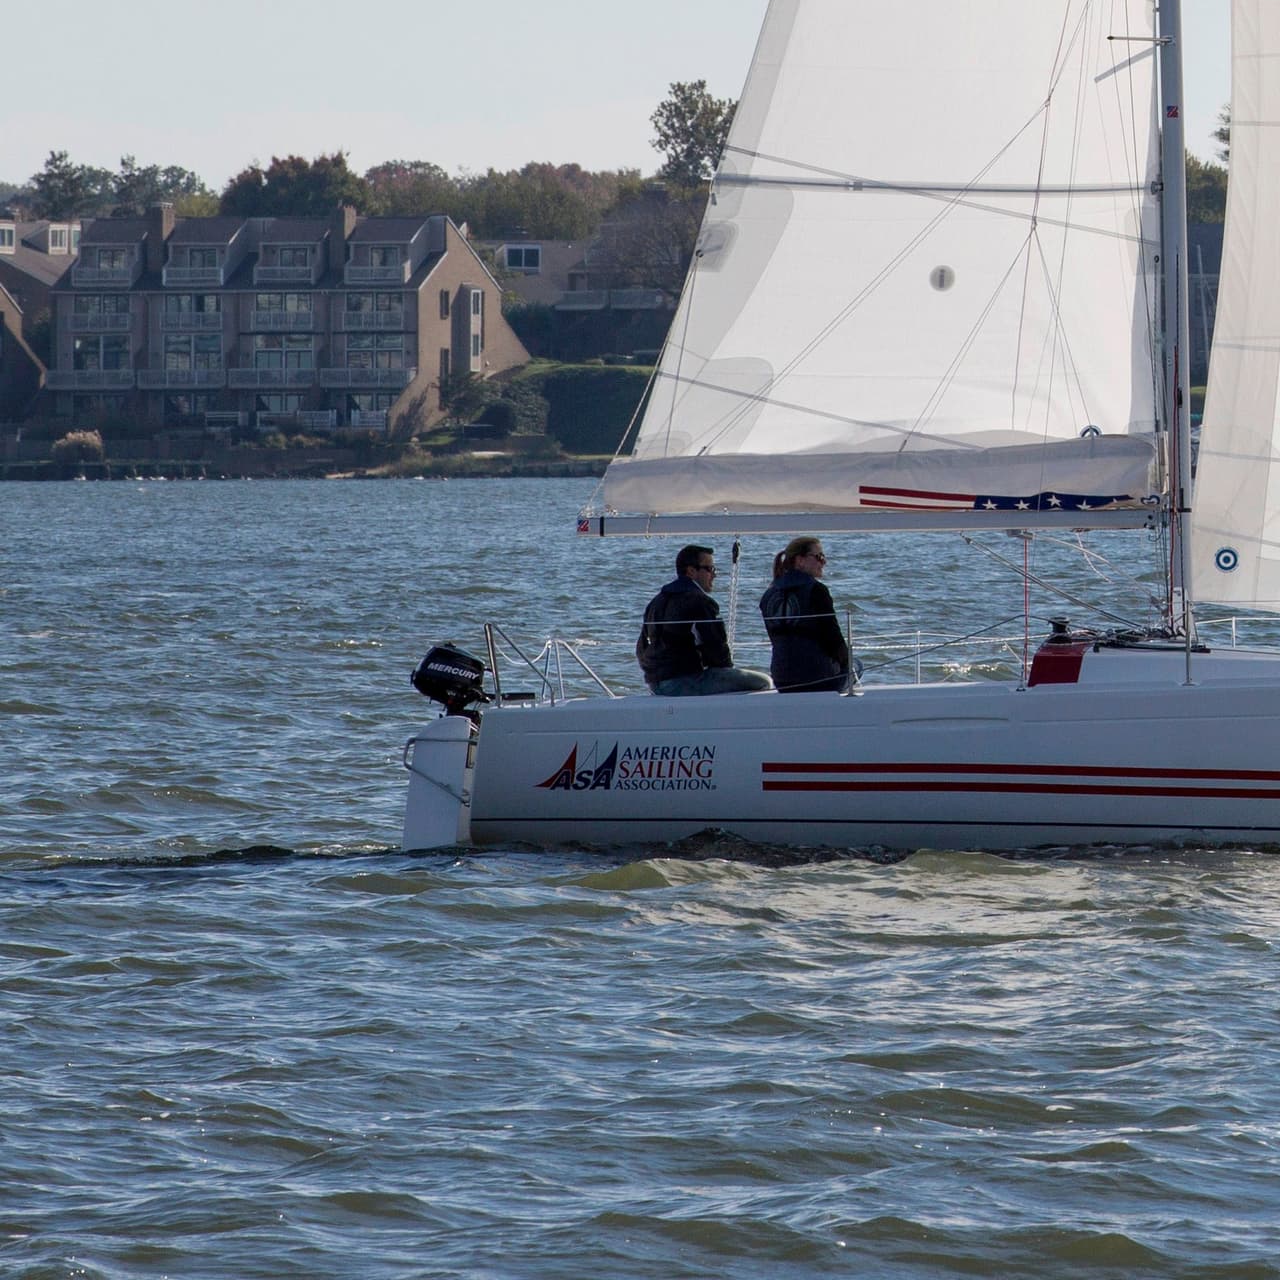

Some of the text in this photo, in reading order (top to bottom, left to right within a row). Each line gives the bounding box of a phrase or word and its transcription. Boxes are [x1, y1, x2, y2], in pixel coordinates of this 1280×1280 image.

[428, 662, 480, 680] MERCURY
[621, 746, 716, 761] AMERICAN
[618, 760, 713, 778] SAILING
[551, 768, 612, 790] ASA
